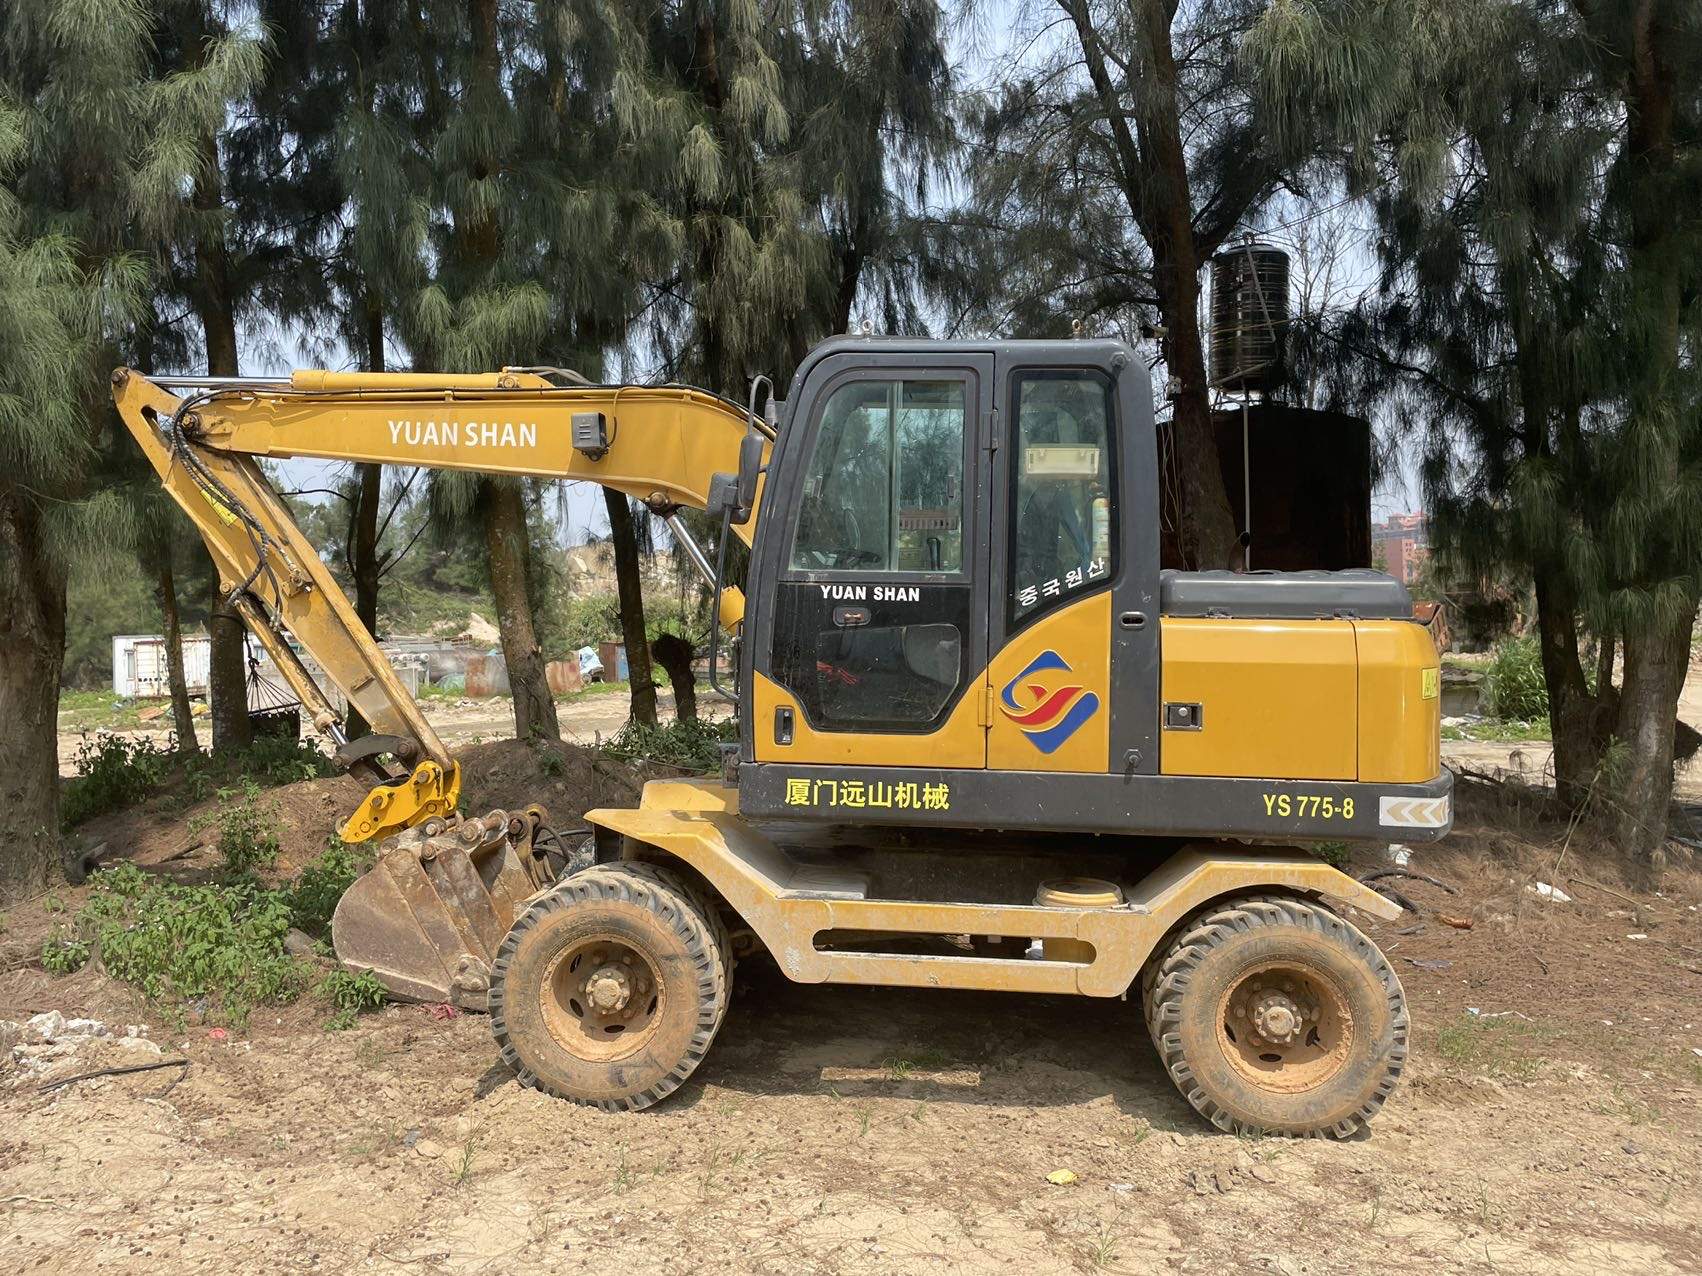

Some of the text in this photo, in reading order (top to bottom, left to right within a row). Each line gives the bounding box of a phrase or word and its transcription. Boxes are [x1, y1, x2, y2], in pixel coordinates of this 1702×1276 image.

[387, 420, 537, 448] YUAN SHAN
[820, 585, 920, 602] YUAN SHAN
[784, 778, 950, 810] 厦门远山机械
[1262, 794, 1355, 819] YS 775-8
